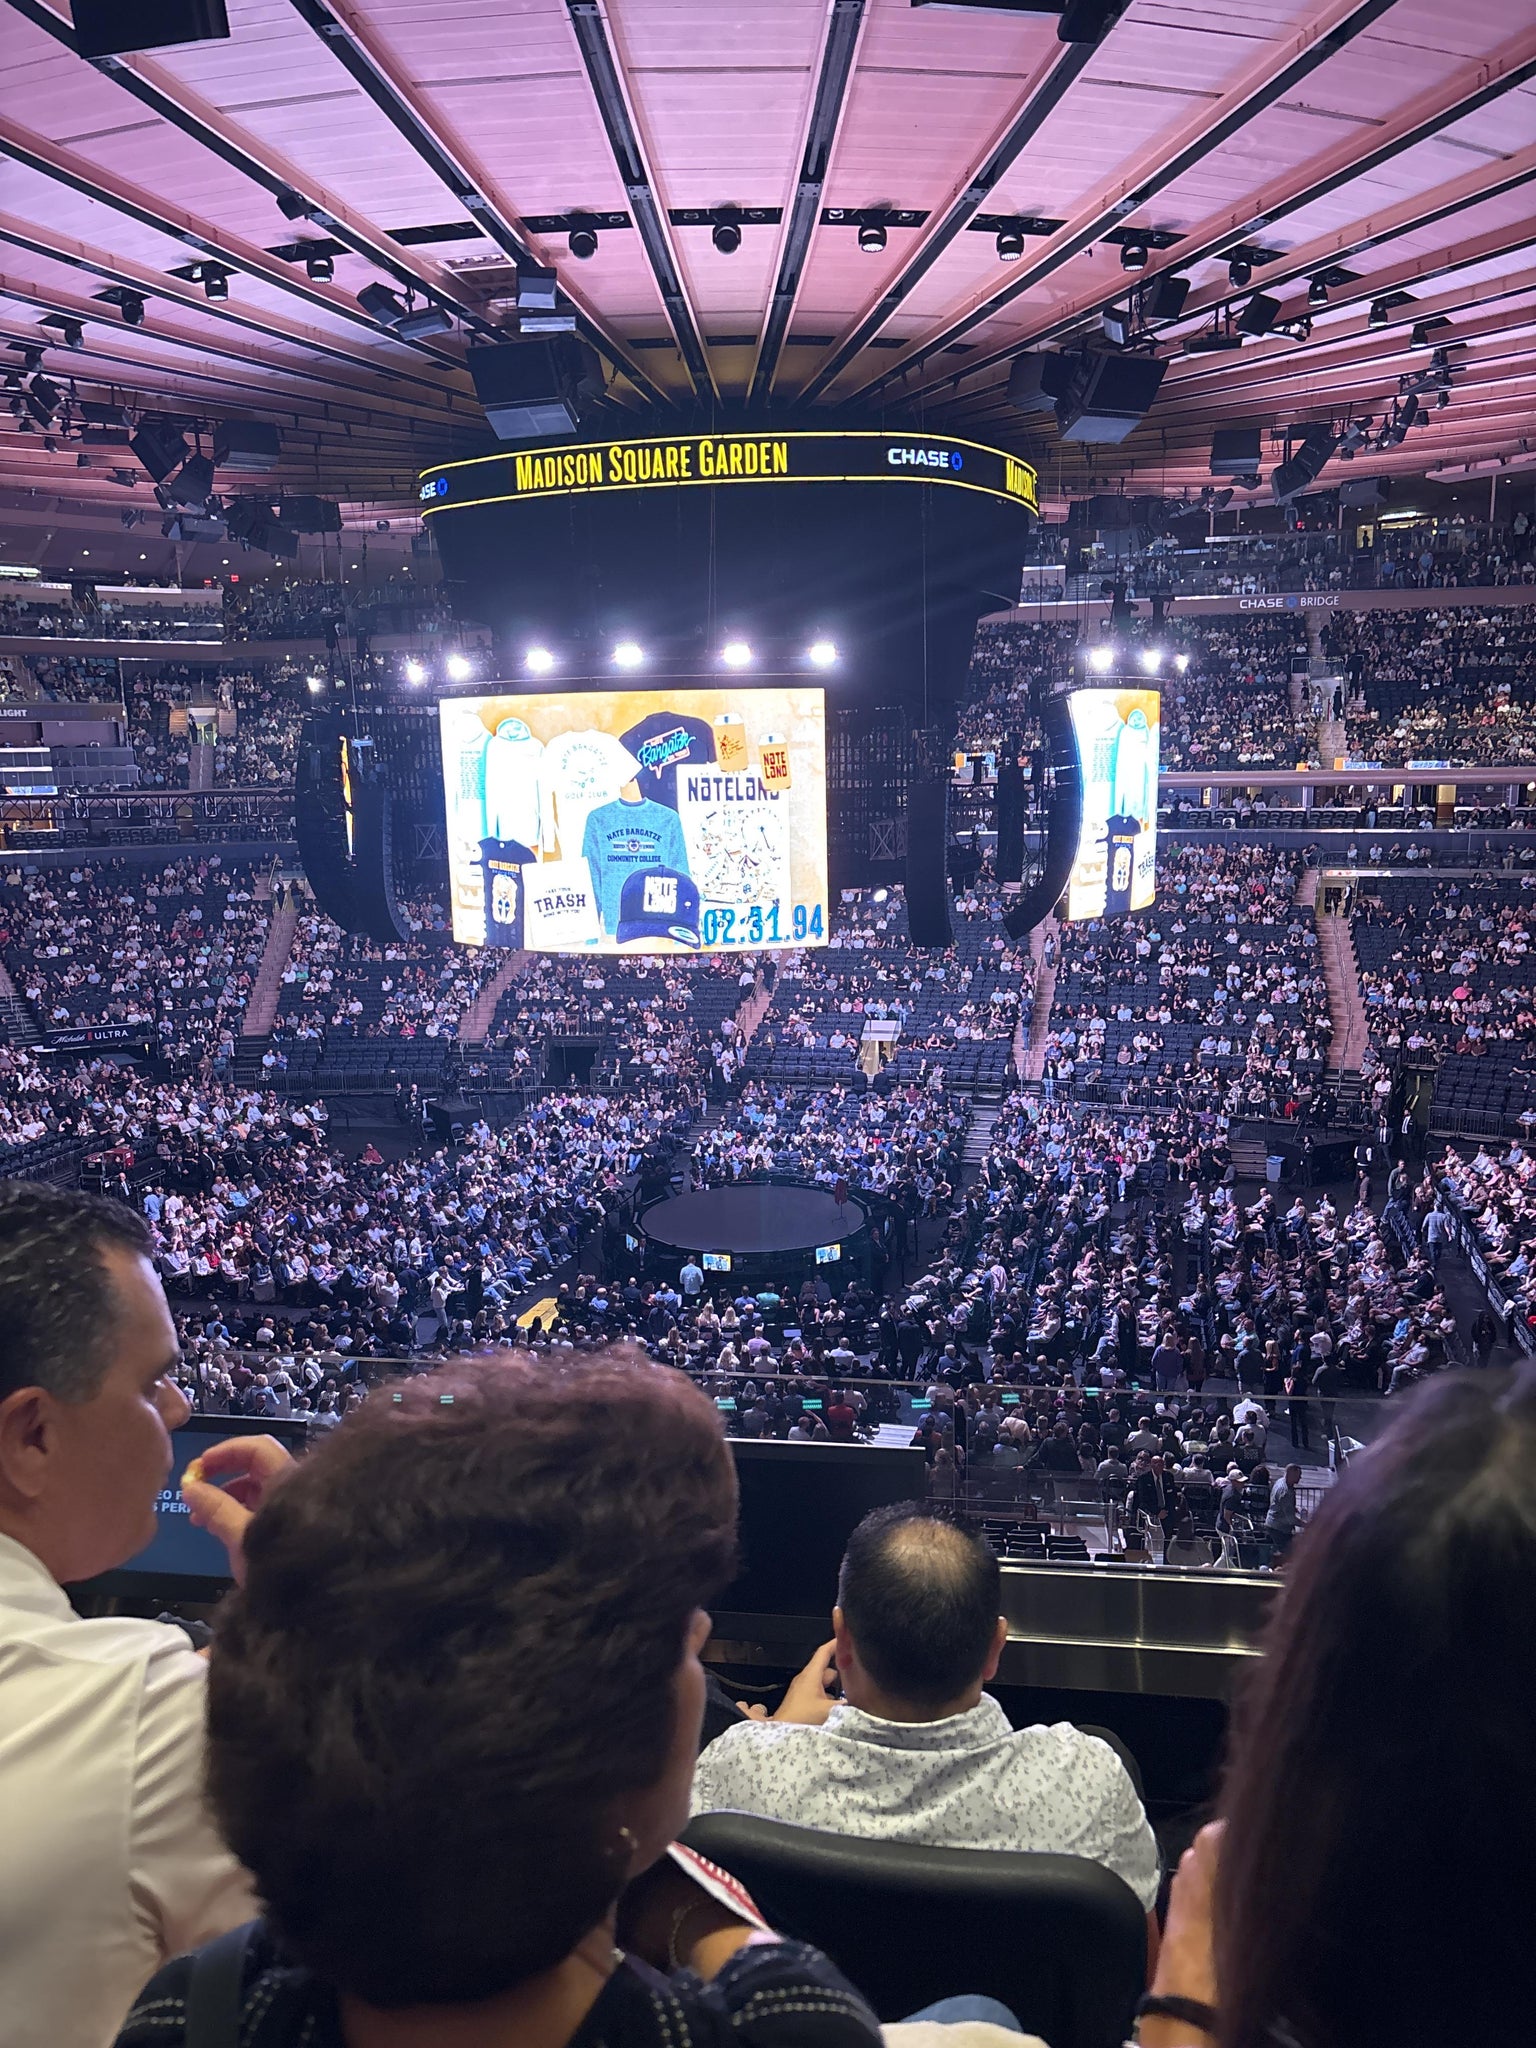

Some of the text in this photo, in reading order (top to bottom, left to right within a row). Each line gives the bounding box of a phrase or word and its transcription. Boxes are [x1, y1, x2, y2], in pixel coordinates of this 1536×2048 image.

[516, 440, 788, 490] MADISON SQUARE GARDEN
[888, 448, 949, 467] CHASE
[1240, 596, 1339, 609] CHASE BRIDGE
[606, 828, 625, 841] NATE
[534, 894, 586, 913] TRASH
[94, 1030, 129, 1040] ULTRA
